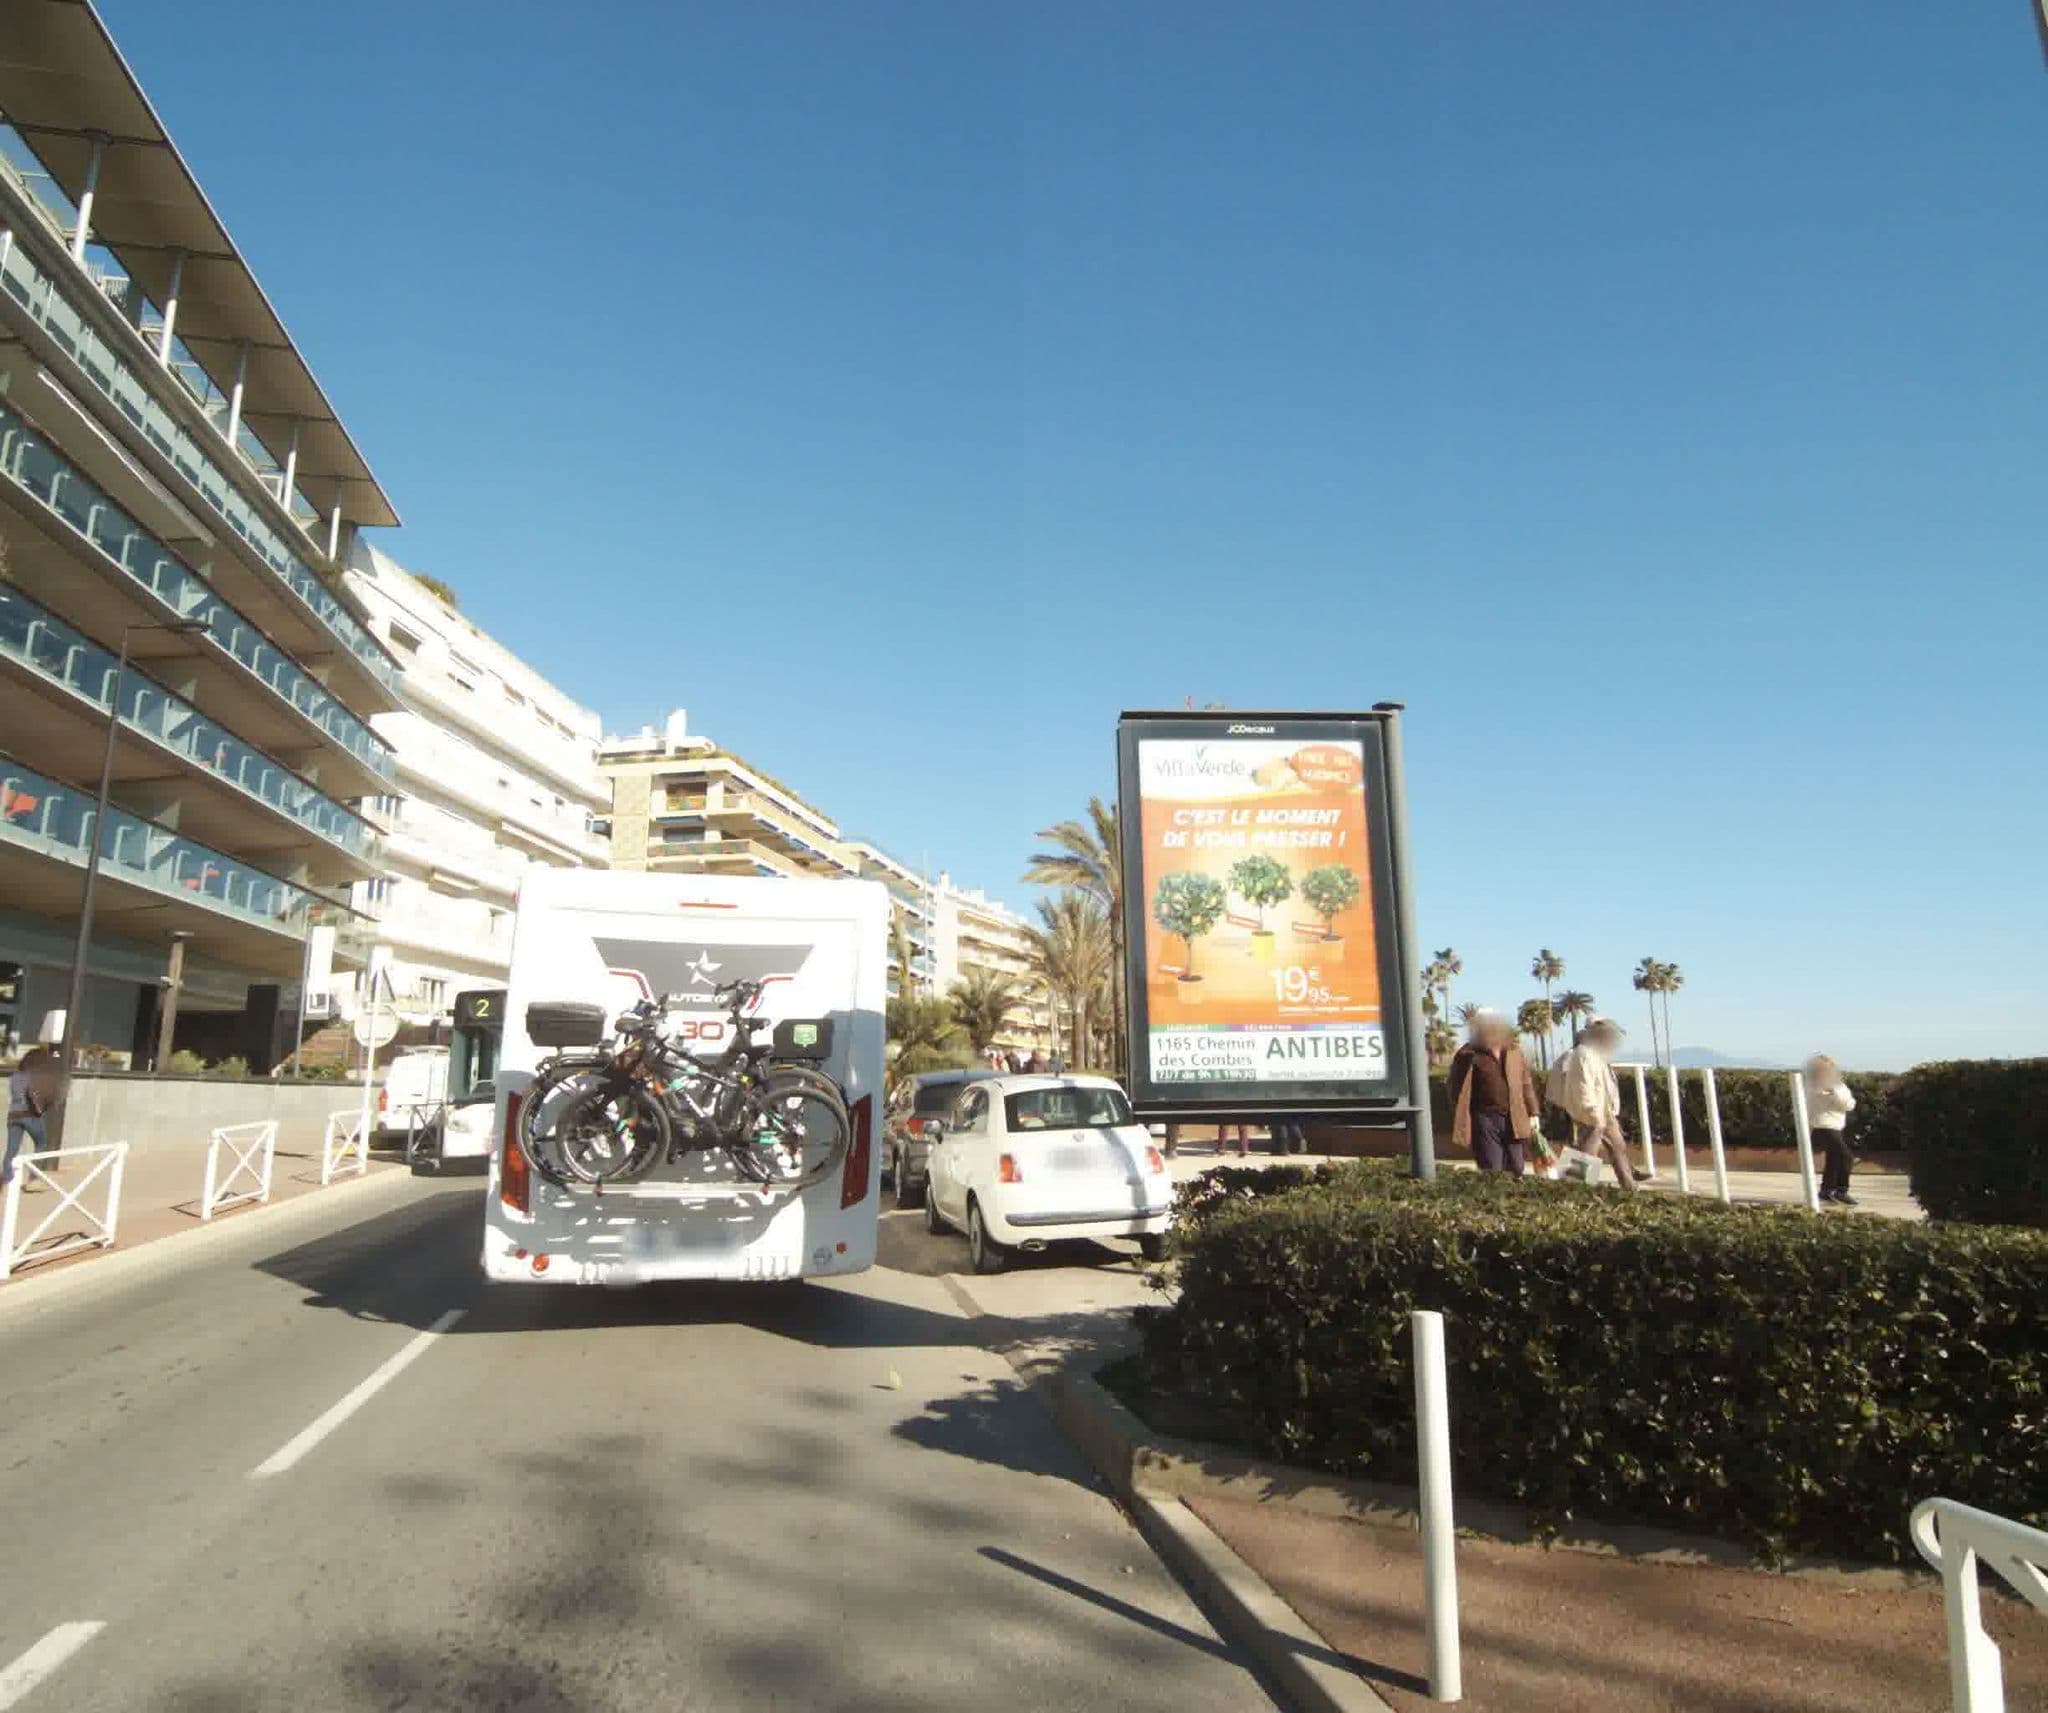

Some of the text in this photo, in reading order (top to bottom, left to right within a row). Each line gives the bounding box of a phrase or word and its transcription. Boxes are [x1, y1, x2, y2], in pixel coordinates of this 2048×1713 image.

[1173, 808, 1341, 826] C'EST LE MOMENT
[1163, 830, 1189, 848] DE
[475, 998, 490, 1018] 2
[681, 1020, 725, 1041] 30
[1157, 1036, 1257, 1051] 1165 Chemin
[1265, 1035, 1384, 1059] ANTIBES
[1158, 1053, 1253, 1067] des Combes
